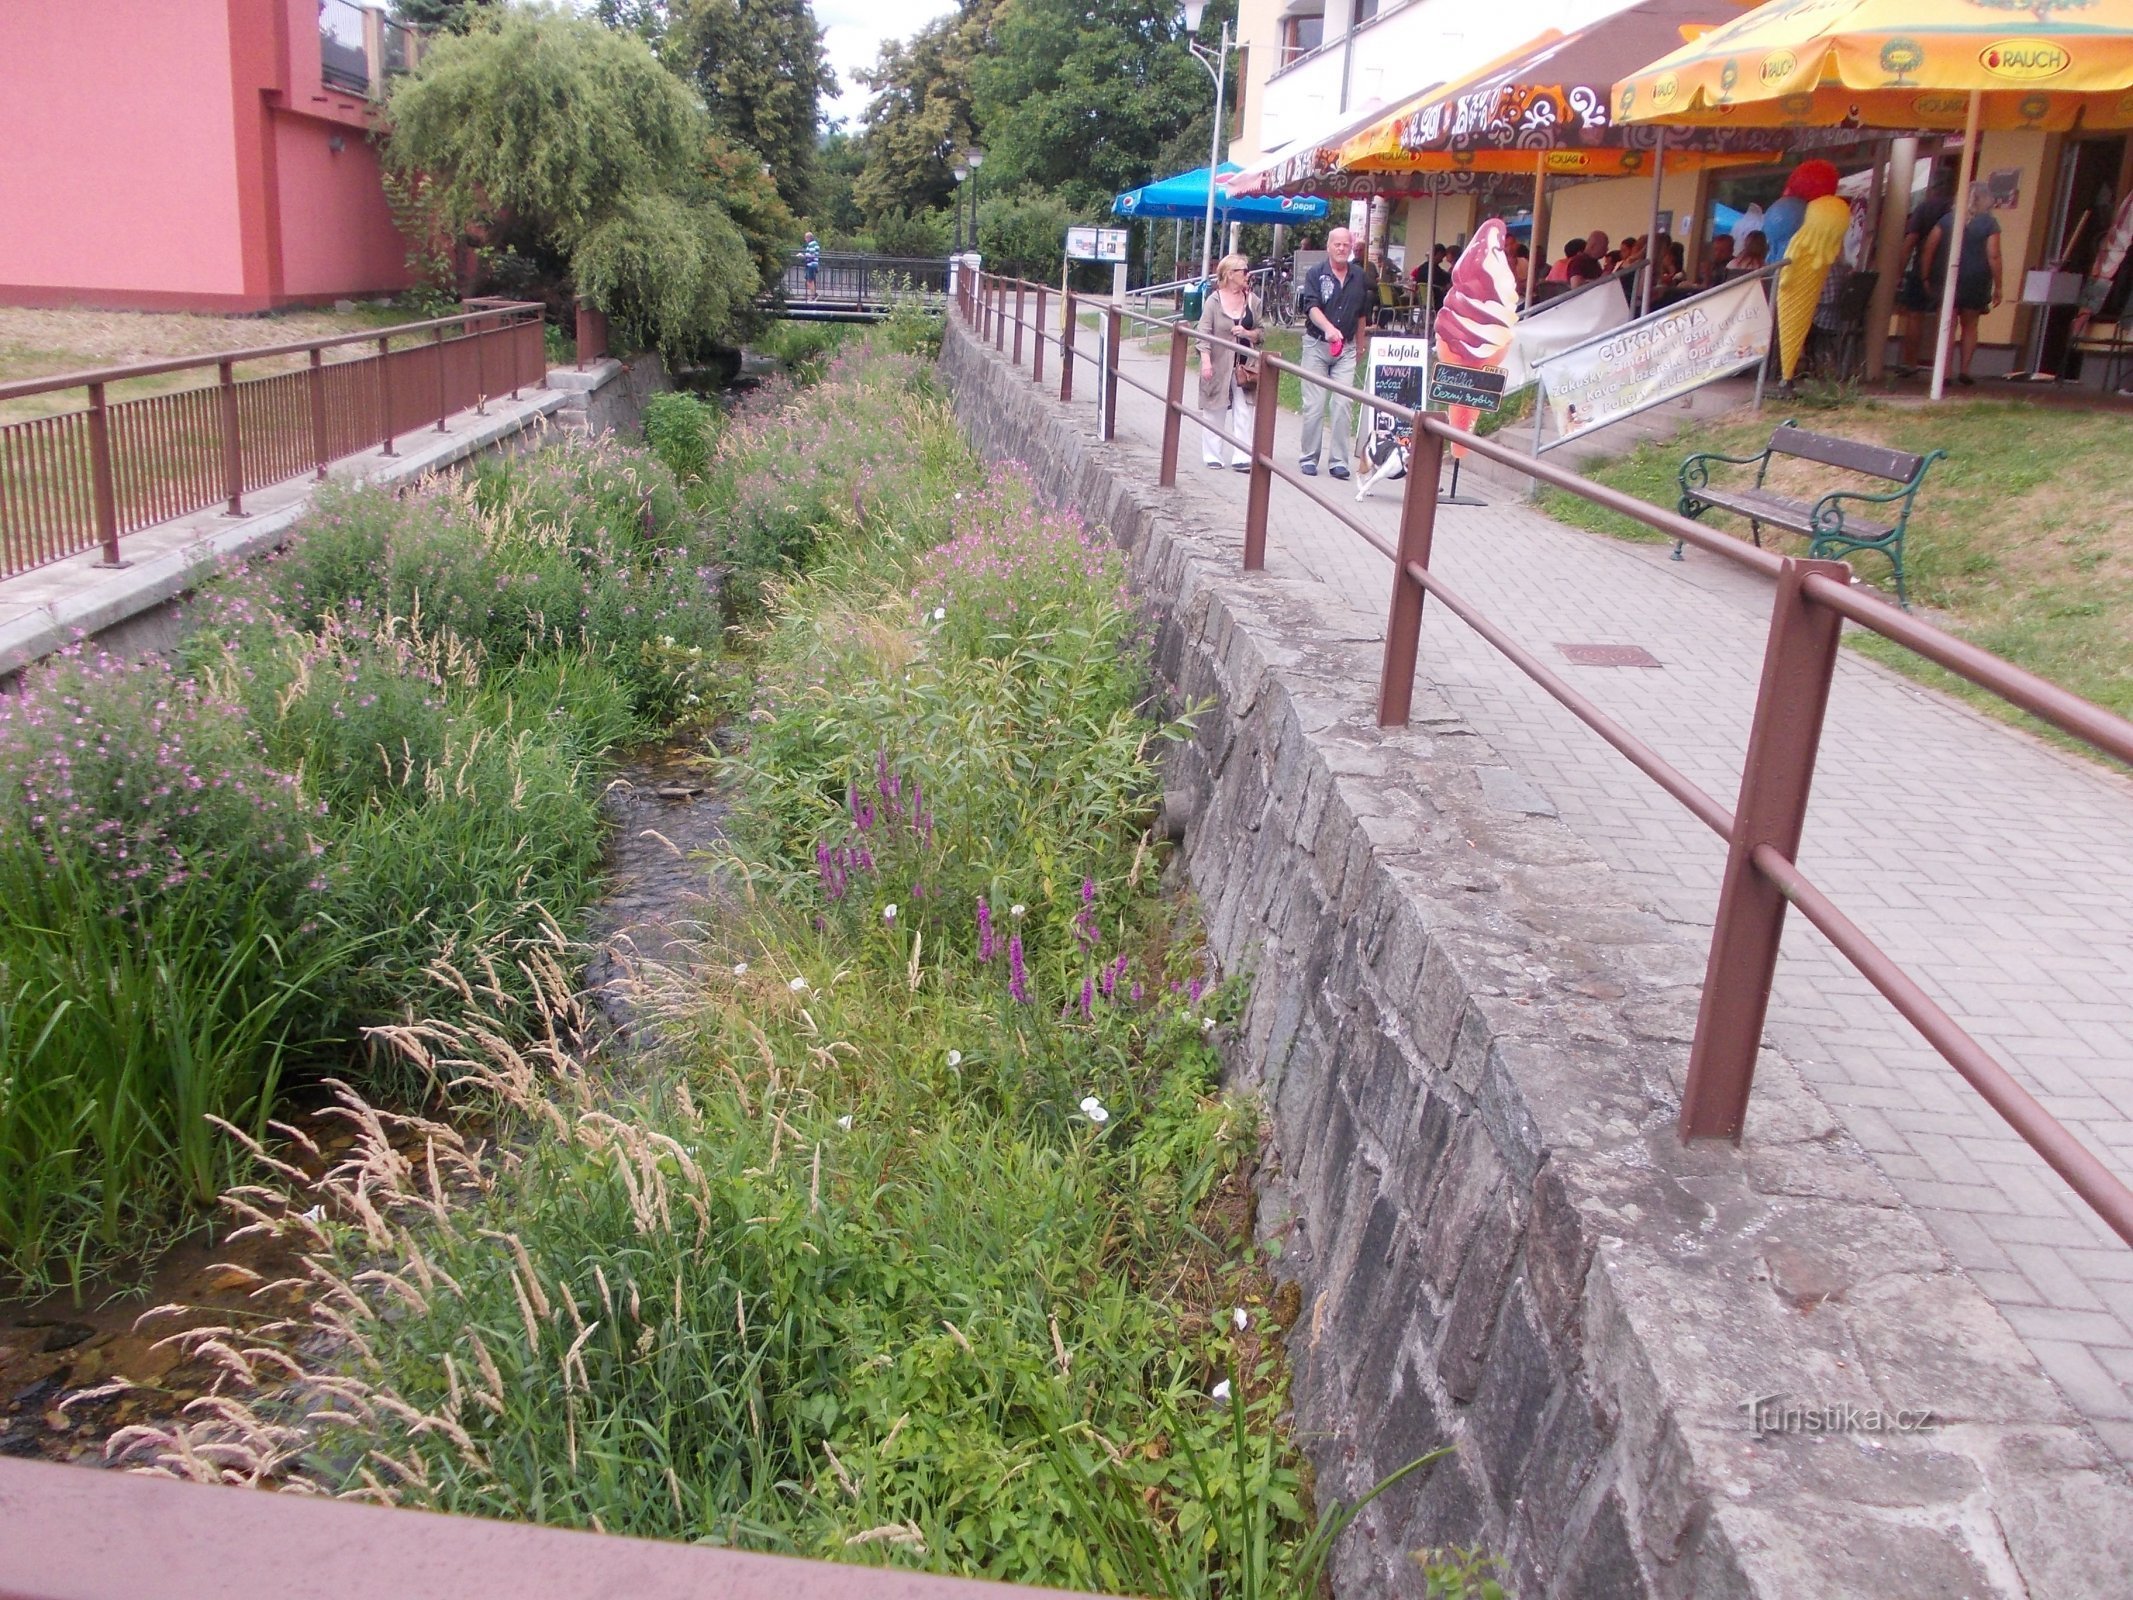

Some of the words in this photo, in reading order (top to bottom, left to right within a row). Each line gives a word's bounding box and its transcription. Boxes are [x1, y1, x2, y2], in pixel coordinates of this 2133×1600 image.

[1767, 57, 1794, 79] RAUCH
[2003, 50, 2061, 69] RAUCH
[1292, 202, 1316, 212] pepsi
[1388, 344, 1420, 361] kofola
